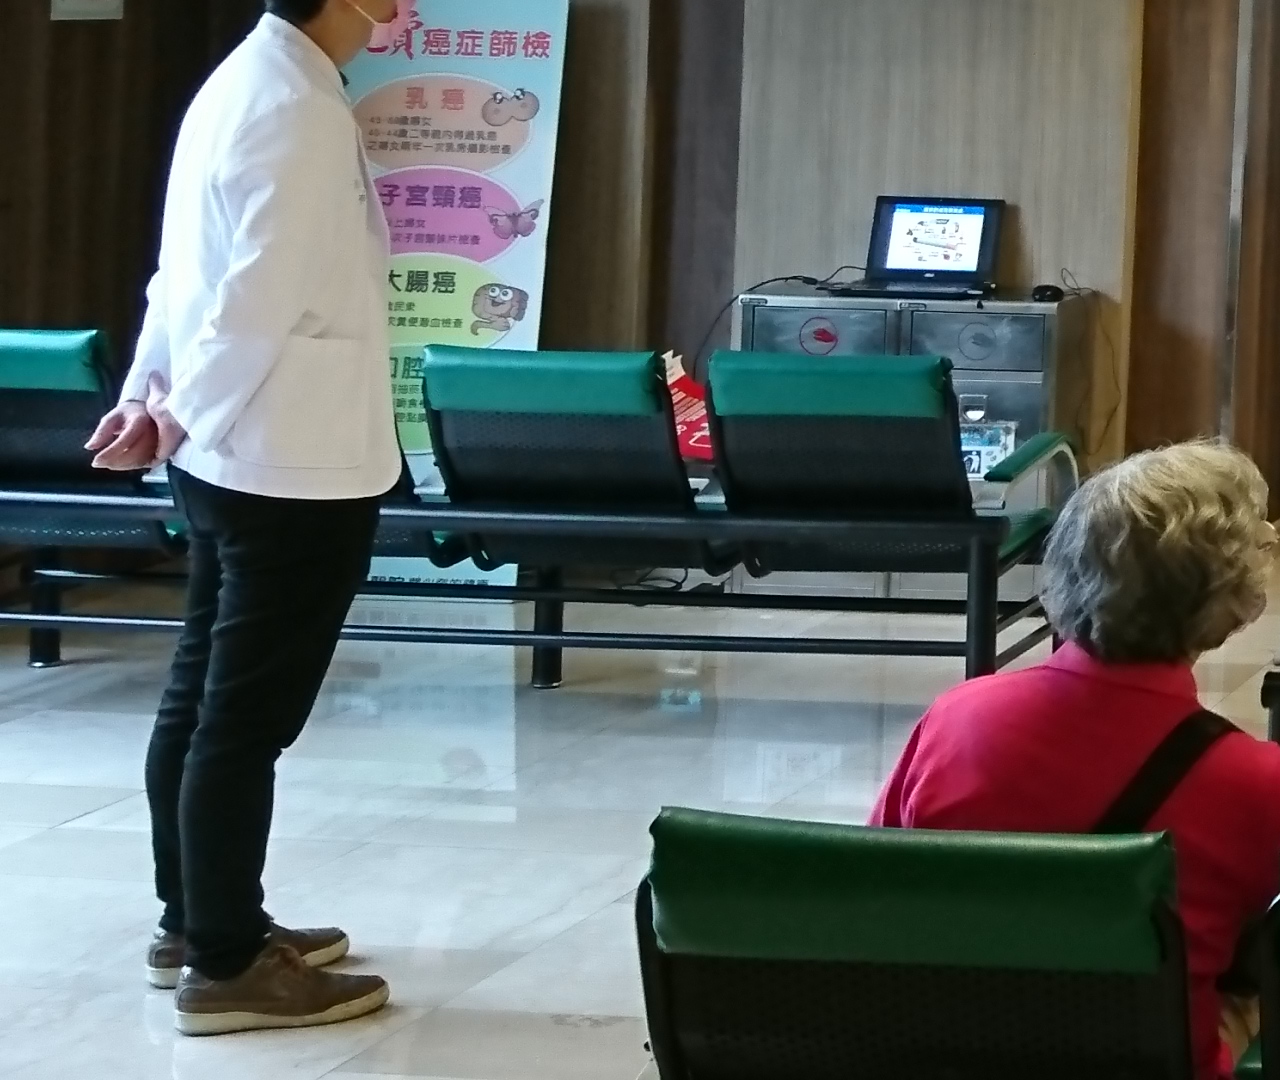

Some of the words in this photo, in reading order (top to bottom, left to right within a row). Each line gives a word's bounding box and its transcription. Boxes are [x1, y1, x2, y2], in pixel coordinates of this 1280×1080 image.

[405, 87, 464, 110] 乳癌
[379, 184, 482, 209] 子宮頸癌
